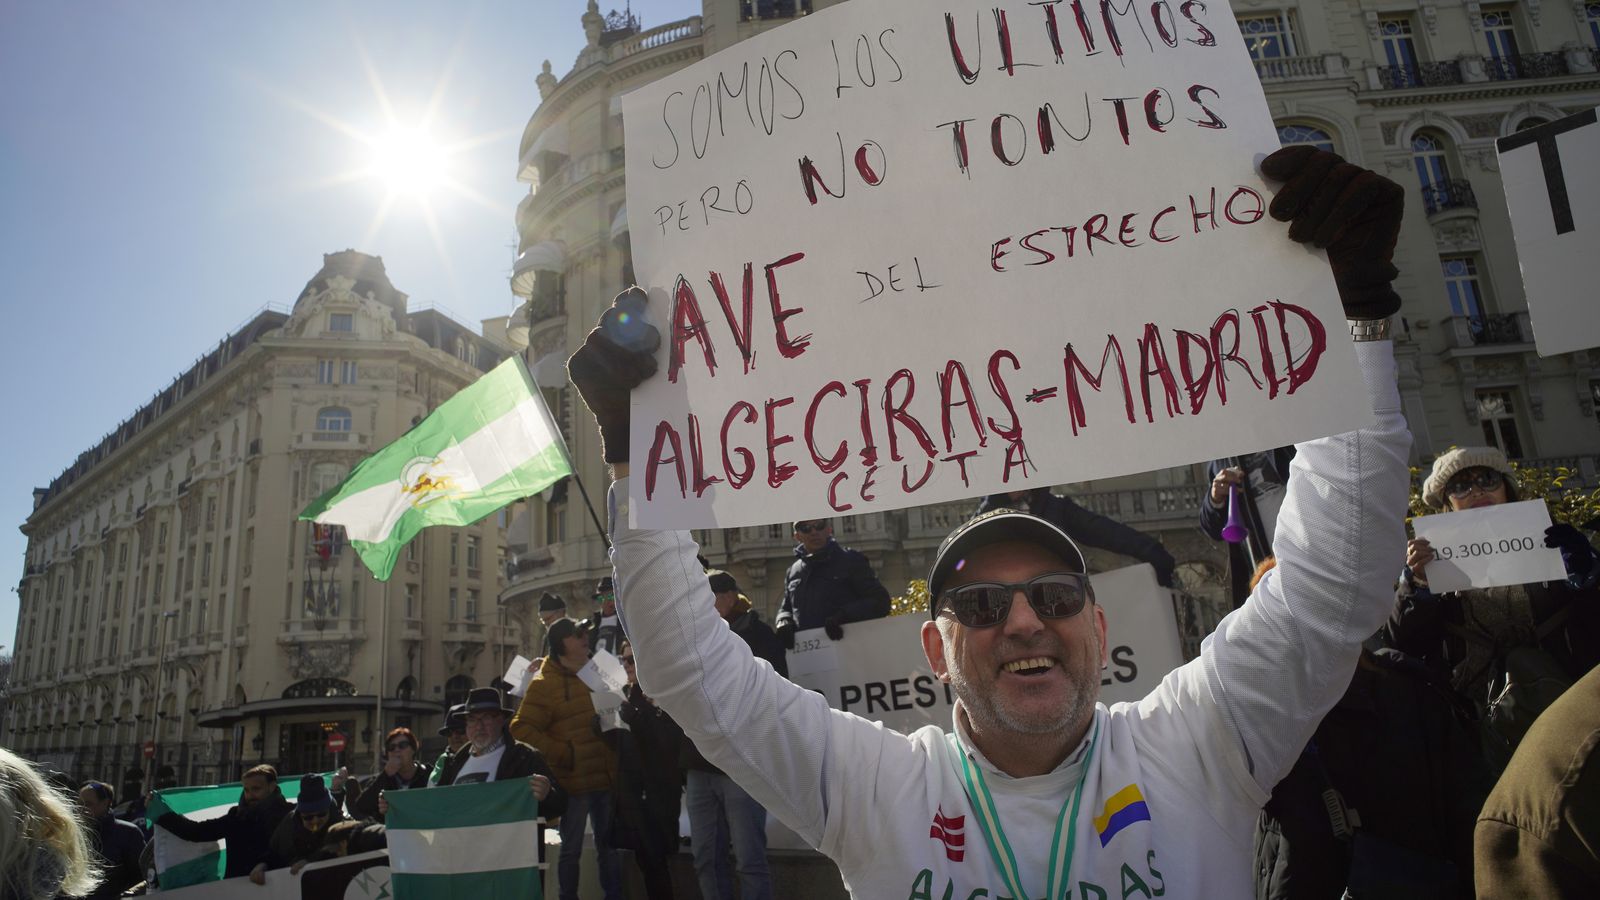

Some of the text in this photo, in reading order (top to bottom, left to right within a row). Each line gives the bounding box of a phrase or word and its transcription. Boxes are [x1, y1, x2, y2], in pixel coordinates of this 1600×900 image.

[652, 50, 804, 169] SOMOS
[831, 28, 903, 98] LOS
[654, 84, 1227, 236] PERO NO TONTOS
[668, 185, 1266, 384] AVE DEL ESTRECHO
[827, 438, 1038, 512] CEUTA
